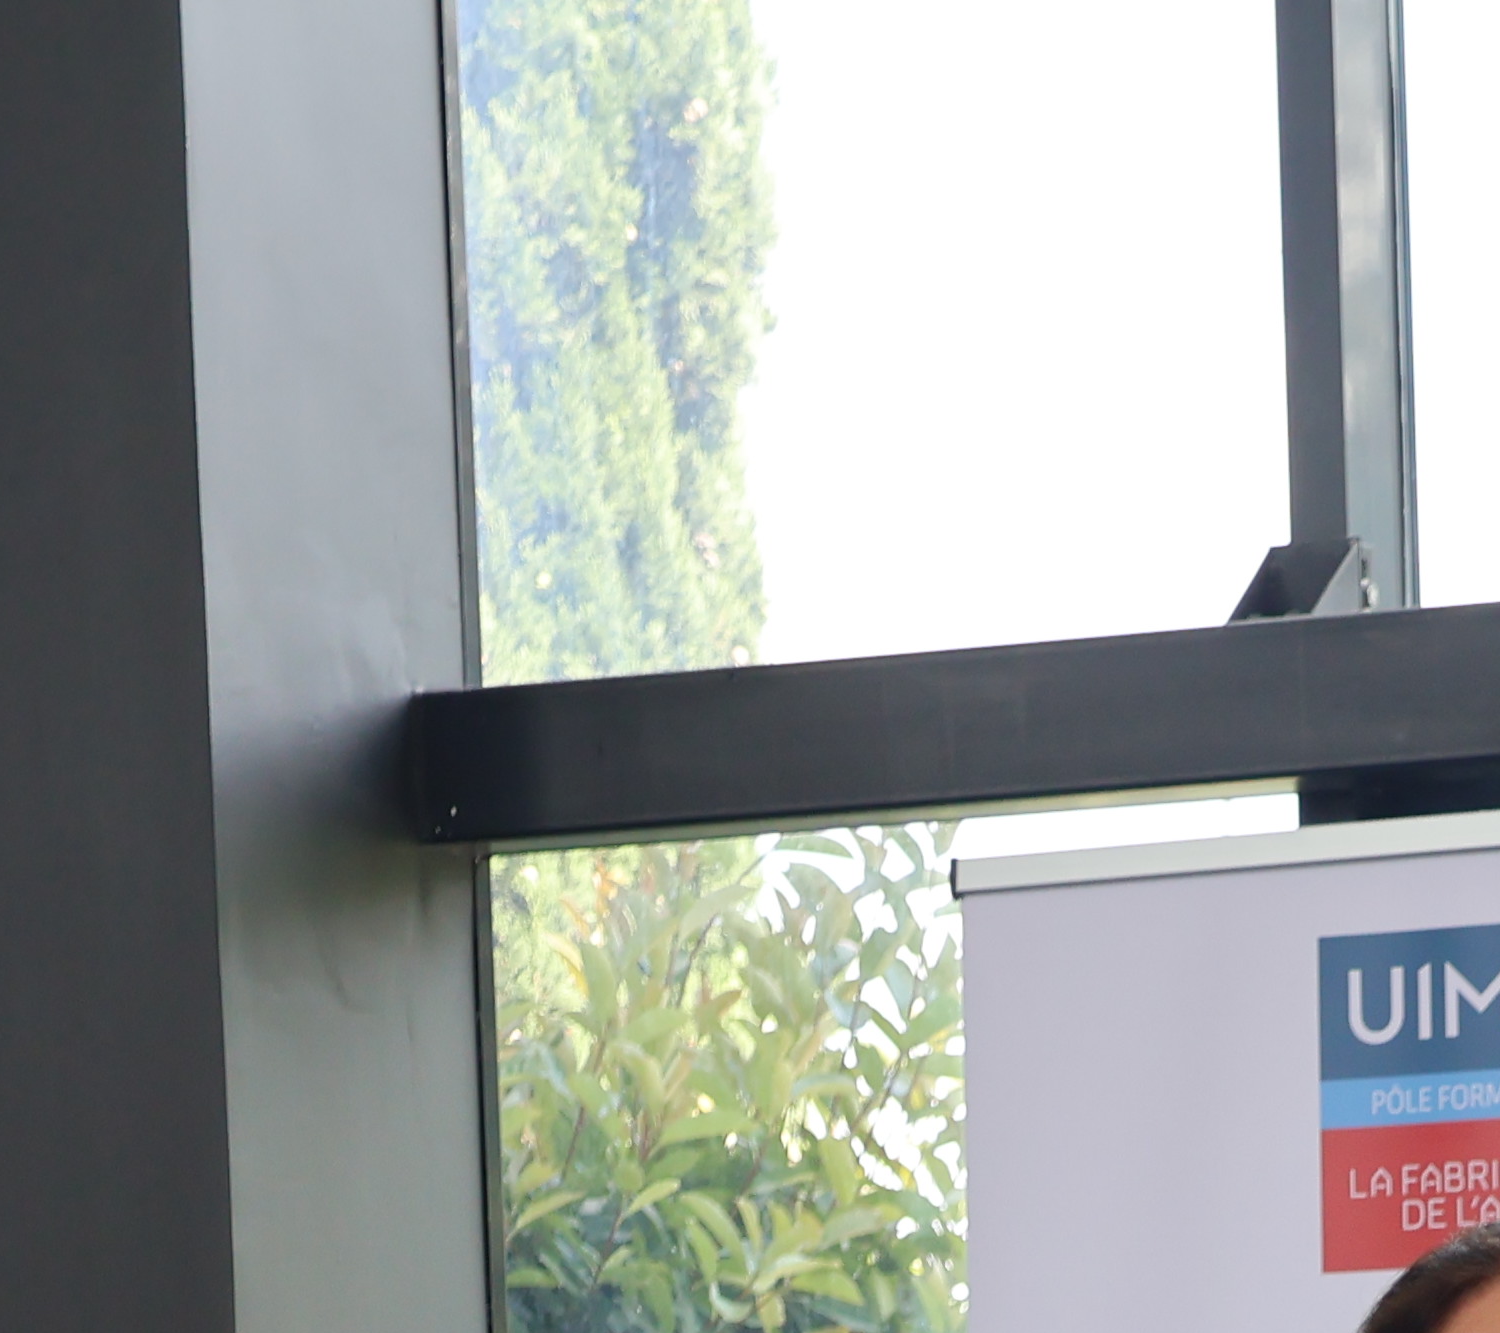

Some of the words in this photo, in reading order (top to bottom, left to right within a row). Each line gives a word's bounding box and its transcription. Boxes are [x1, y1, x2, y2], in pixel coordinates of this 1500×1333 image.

[1371, 1084, 1432, 1116] PÔLE
[1349, 1166, 1394, 1200] LA
[1401, 1197, 1448, 1232] DE
